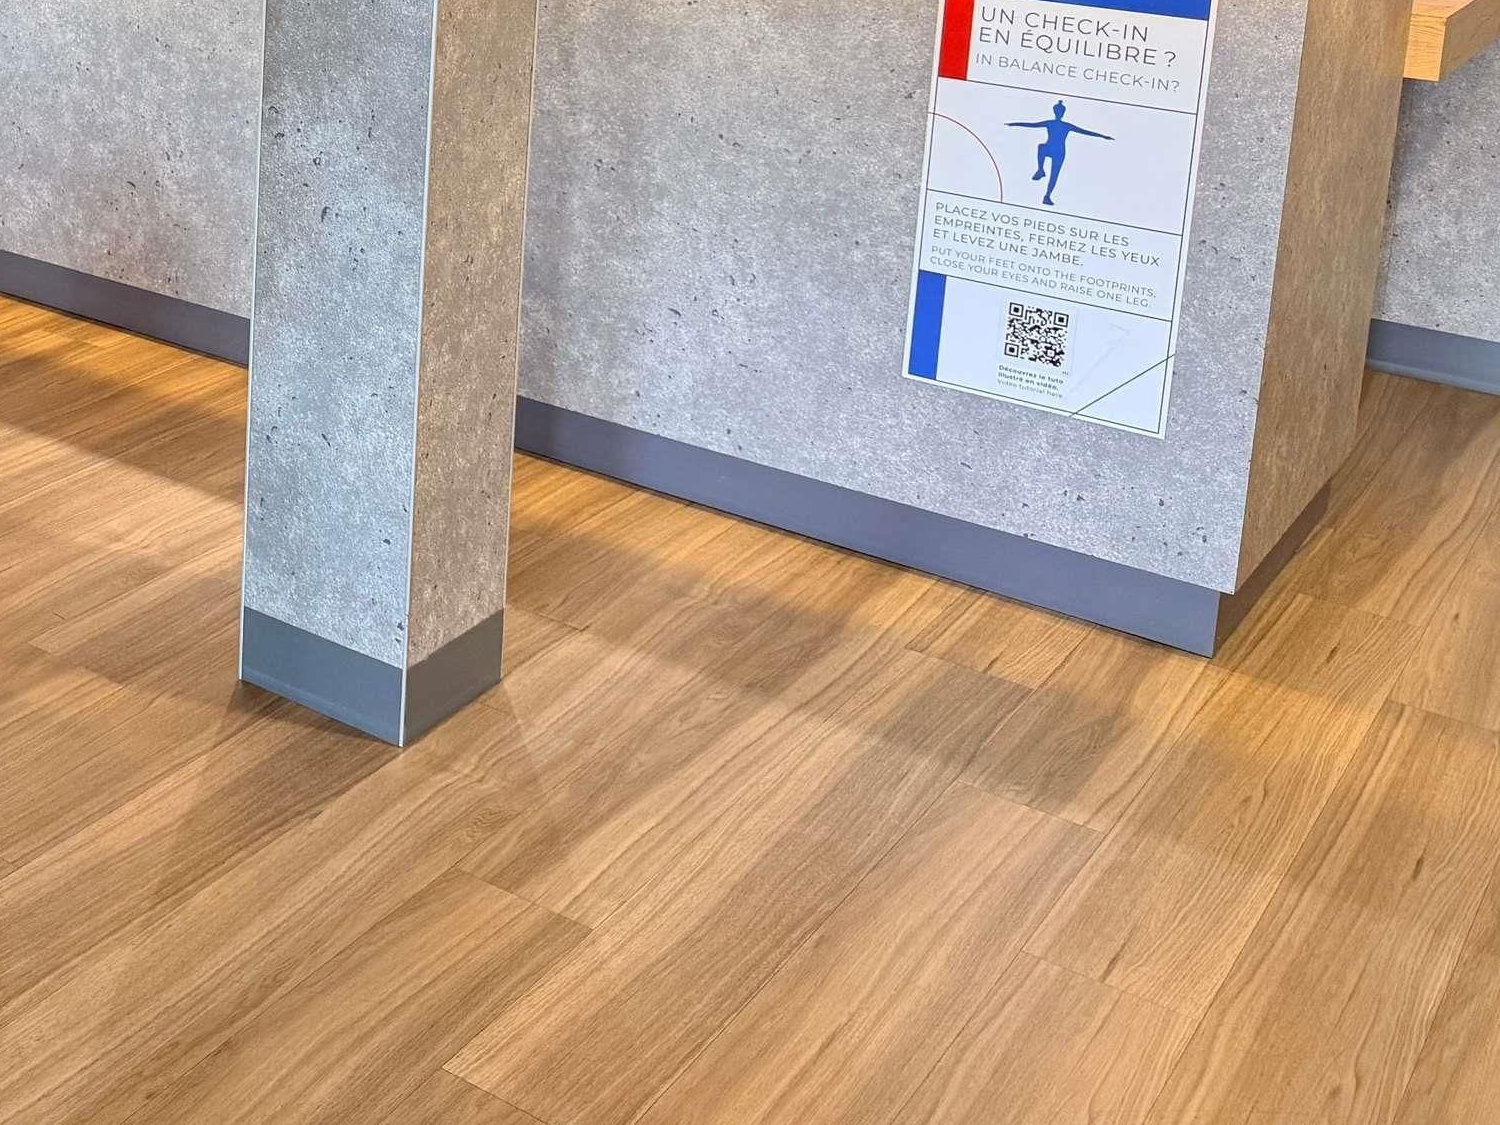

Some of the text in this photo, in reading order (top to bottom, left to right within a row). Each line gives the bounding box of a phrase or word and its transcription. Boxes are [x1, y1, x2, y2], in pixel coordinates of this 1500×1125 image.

[981, 6, 1148, 42] UN CHECK-IN
[979, 26, 1010, 45] EN
[1020, 29, 1158, 66] ÉQUILIBRE
[976, 53, 1180, 92] IN BALANCE CHECK-IN?
[935, 215, 1160, 267] EMPREINTES, FERMEZ LES YEUX
[936, 202, 1130, 247] PLACEZ VOS PIEDS SUR LES
[931, 245, 952, 256] PUT
[955, 250, 986, 263] YOUR
[989, 257, 1016, 269] FEET
[1018, 263, 1051, 276] ONTO
[1054, 270, 1077, 282] THE
[933, 228, 1084, 266] ET LEVEZ UNE JAMBE.
[930, 256, 965, 270] CLOSE
[968, 264, 999, 276] YOUR
[1002, 271, 1029, 283] EYES
[1031, 277, 1057, 289] AND
[1060, 282, 1093, 297] RAISE
[1096, 290, 1123, 302] ONE
[998, 365, 1037, 378] Découvrez
[1048, 376, 1064, 384] tuto
[1019, 384, 1045, 394] tutorial
